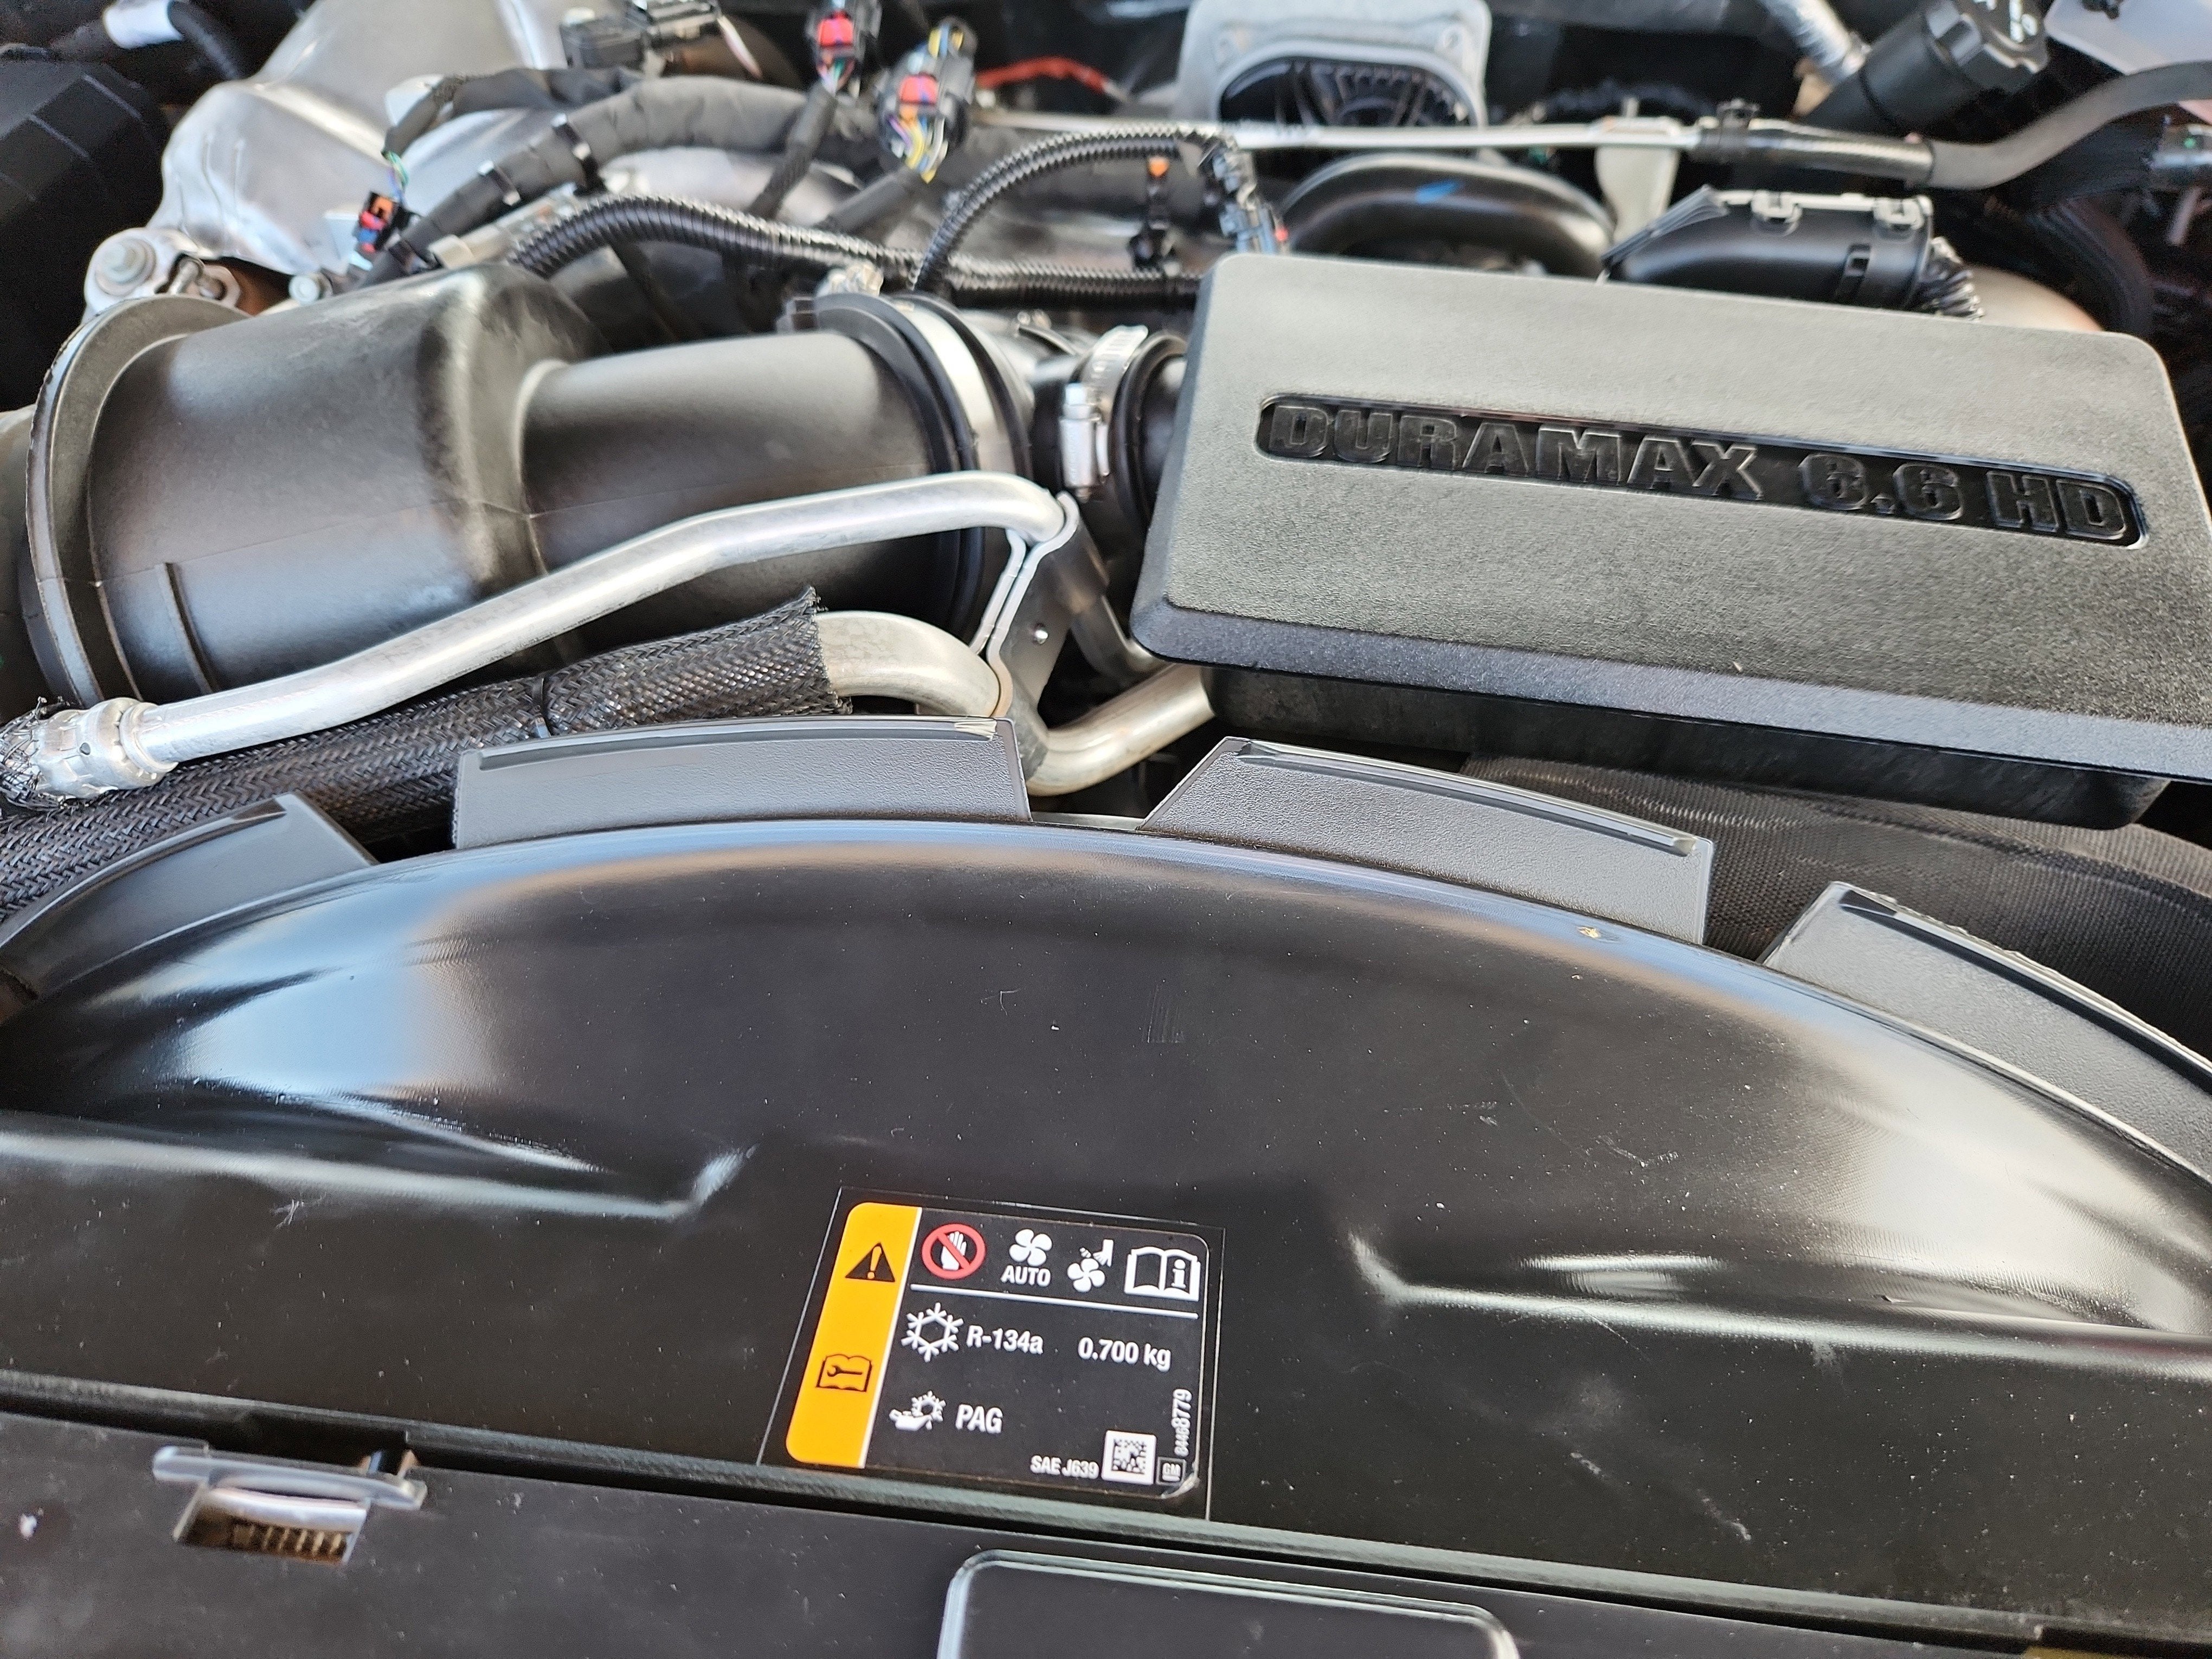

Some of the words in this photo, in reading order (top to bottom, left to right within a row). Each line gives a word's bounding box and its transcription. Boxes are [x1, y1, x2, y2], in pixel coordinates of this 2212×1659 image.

[1269, 404, 1763, 500] DURAMAX
[1800, 453, 1965, 520] 6.6
[1986, 471, 2128, 538] HD
[1001, 1266, 1051, 1287] AUTO
[967, 1325, 1044, 1355] R-134a
[1078, 1337, 1140, 1365] 0.700
[1143, 1343, 1172, 1371] kg
[955, 1404, 1003, 1434] PAG
[1031, 1455, 1062, 1475] SAE
[1063, 1459, 1099, 1480] J639
[1162, 1462, 1181, 1477] GM
